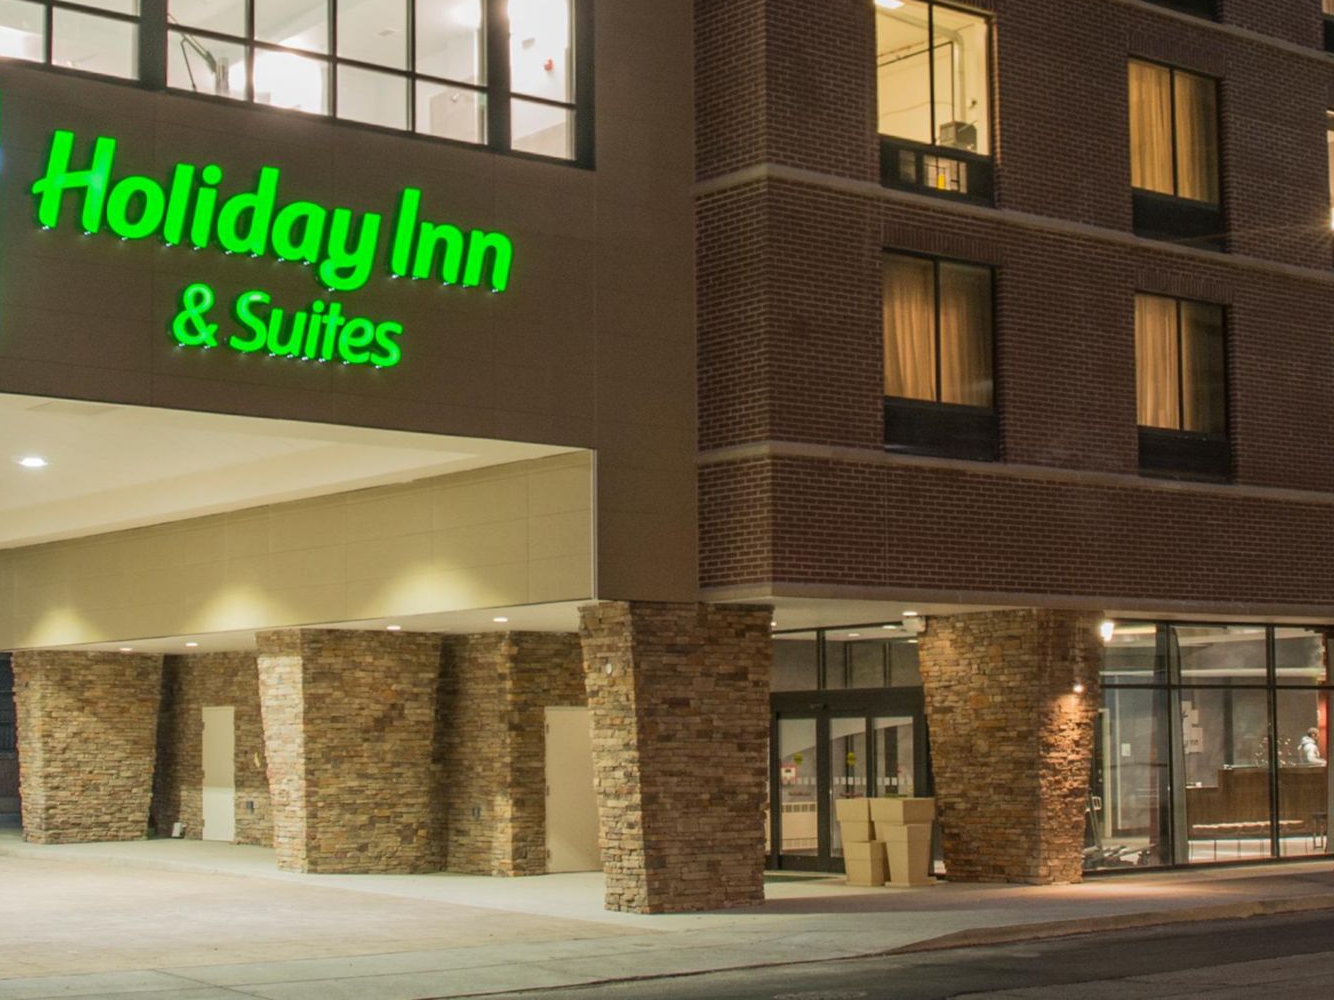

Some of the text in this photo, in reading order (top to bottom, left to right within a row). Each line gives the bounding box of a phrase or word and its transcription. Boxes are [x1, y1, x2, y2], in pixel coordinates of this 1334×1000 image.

[32, 130, 513, 292] Holiday Inn
[172, 283, 403, 368] & Suites
